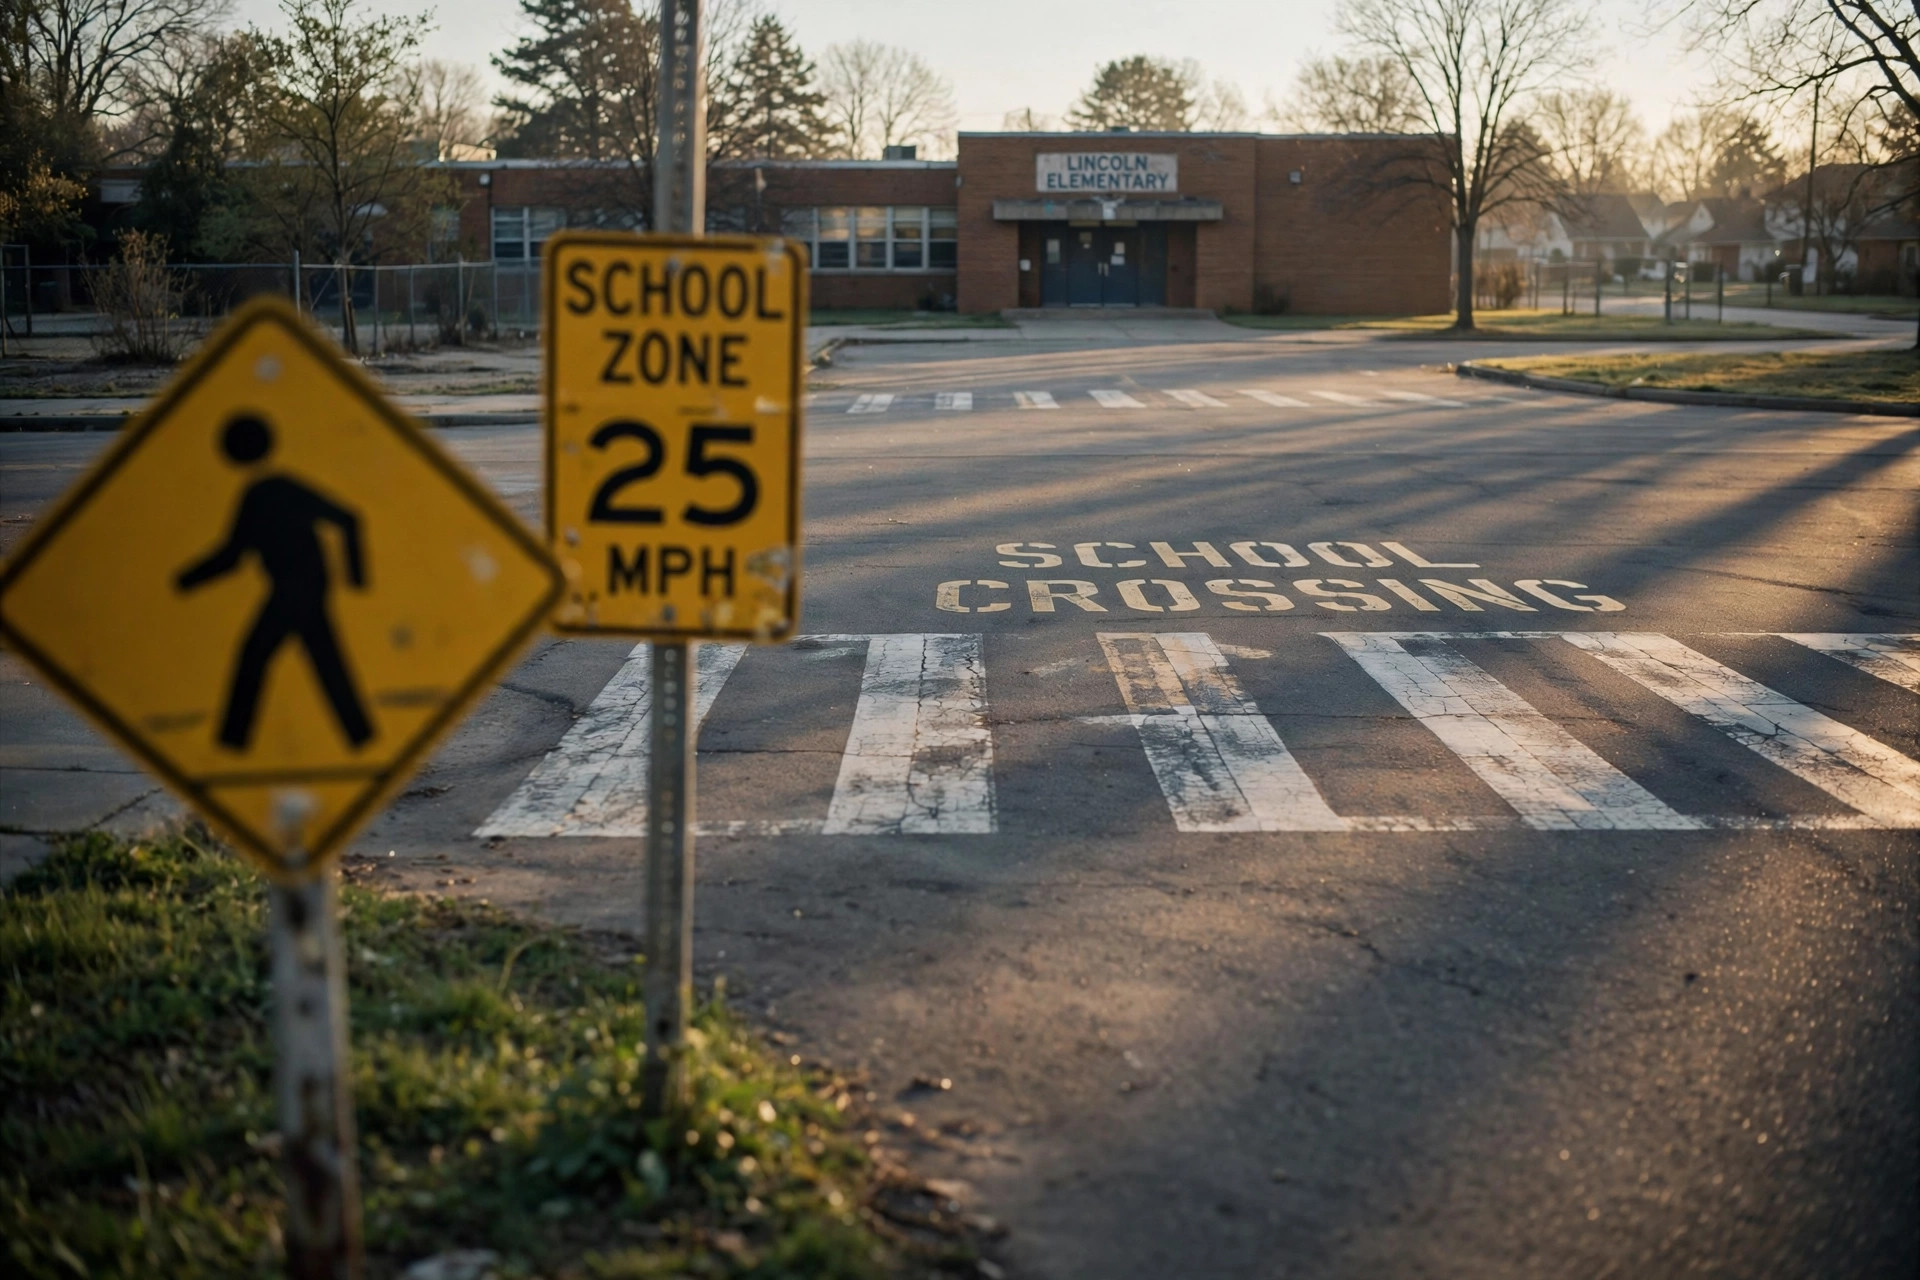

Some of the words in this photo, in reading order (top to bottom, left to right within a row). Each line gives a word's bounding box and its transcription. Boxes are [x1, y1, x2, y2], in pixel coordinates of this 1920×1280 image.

[1047, 173, 1168, 189] ELEMENTARY
[1067, 155, 1148, 171] LINCOLN
[565, 260, 783, 321] SCHOOL
[600, 330, 749, 387] ZONE
[587, 418, 761, 527] 25
[606, 544, 735, 597] MPH
[995, 541, 1481, 569] SCHOOL
[935, 579, 1627, 613] CROSSING
